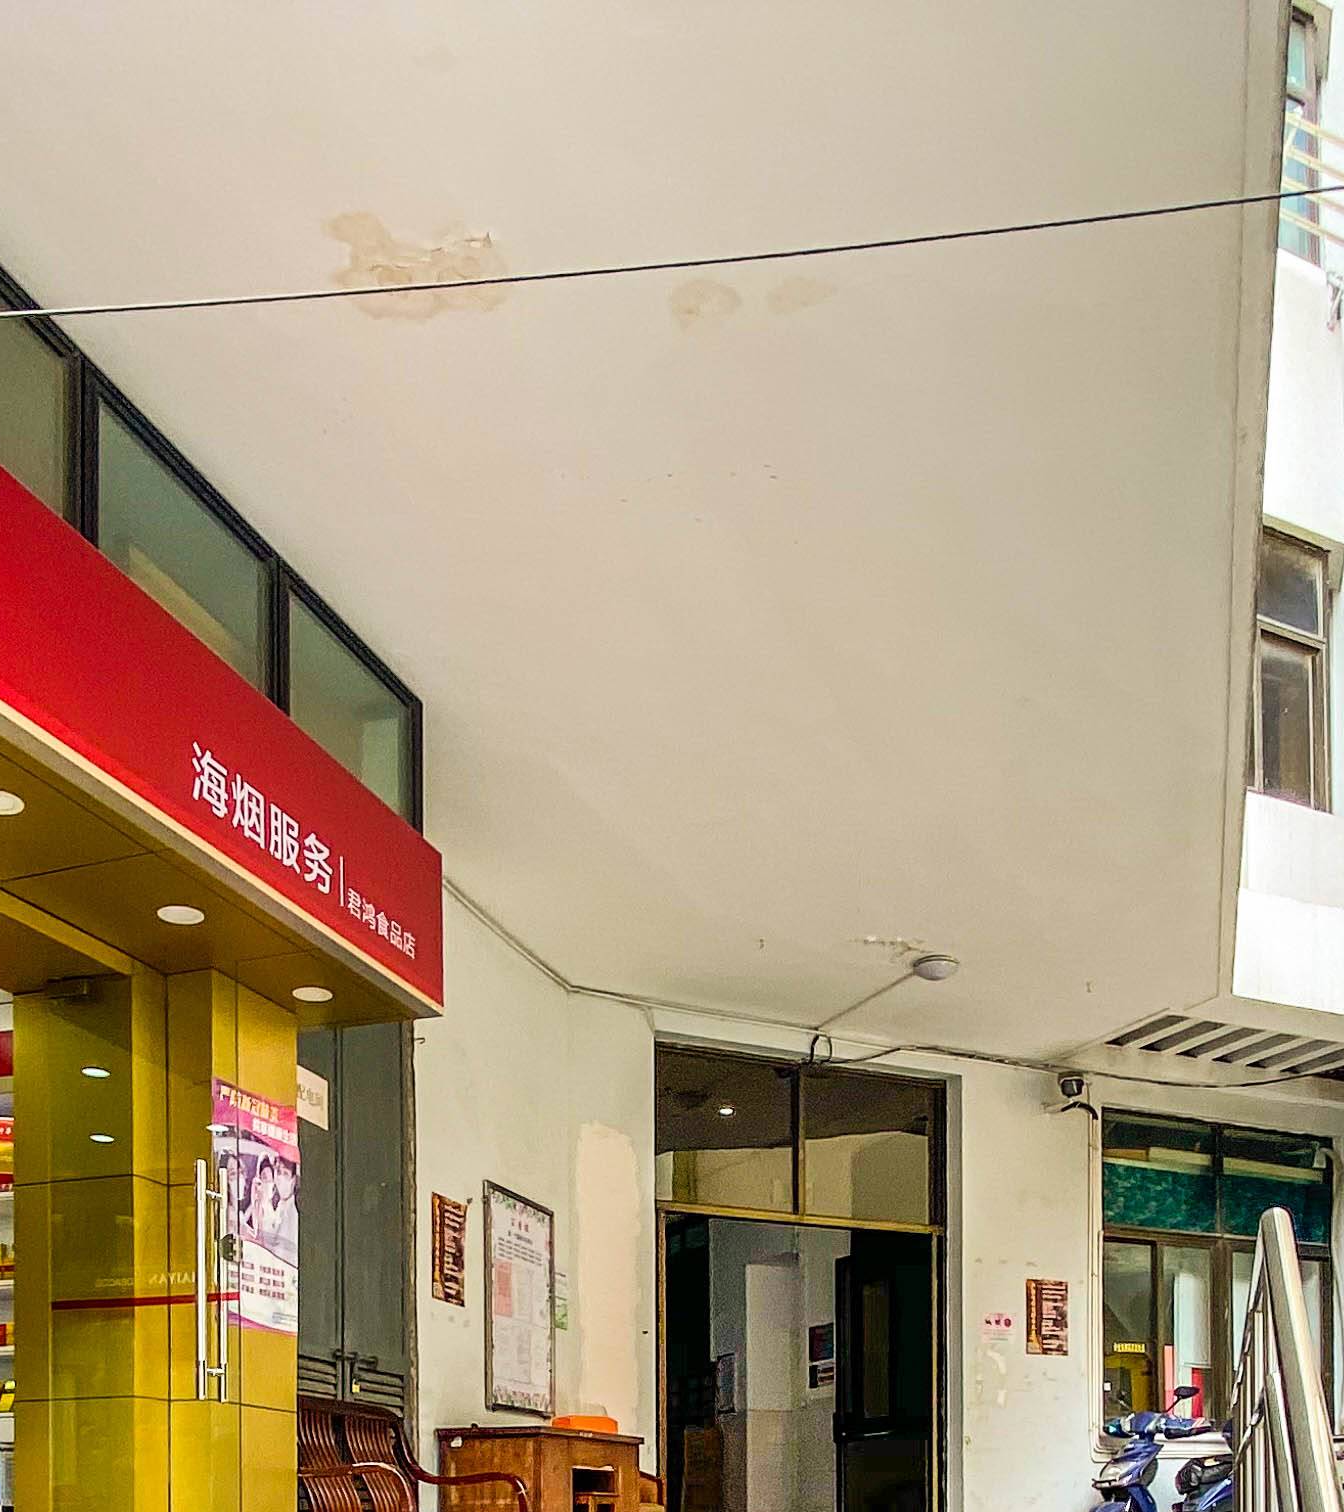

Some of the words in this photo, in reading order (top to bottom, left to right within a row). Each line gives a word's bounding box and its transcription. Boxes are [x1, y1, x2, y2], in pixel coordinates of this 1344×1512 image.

[192, 741, 333, 894] 海烟服务
[347, 887, 416, 960] 君鸿食品店
